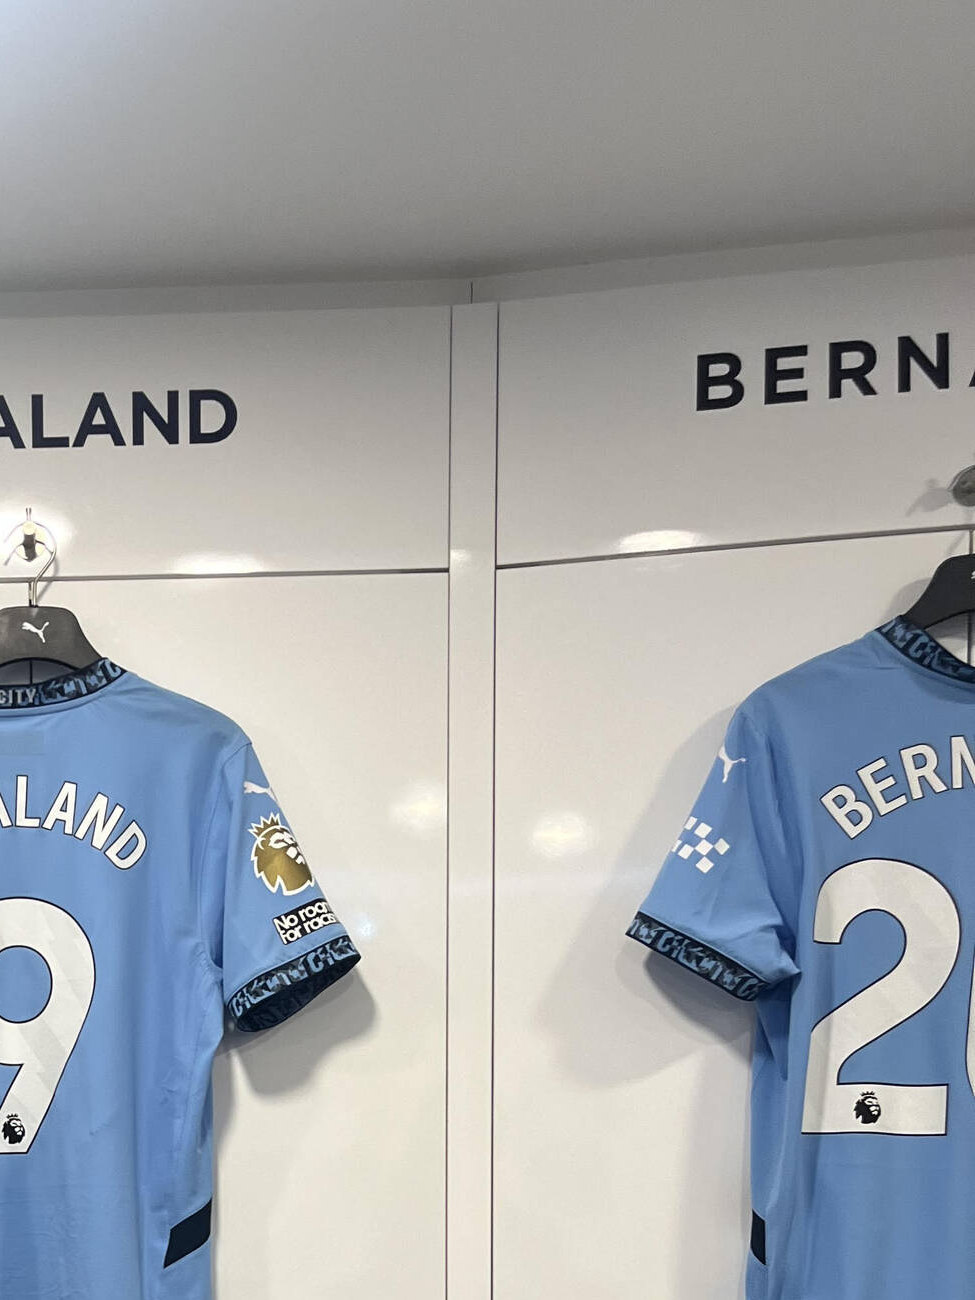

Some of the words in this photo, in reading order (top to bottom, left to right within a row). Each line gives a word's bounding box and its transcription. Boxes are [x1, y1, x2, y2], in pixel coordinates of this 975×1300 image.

[696, 332, 975, 412] BERN
[273, 915, 299, 930] No
[279, 924, 303, 945] for
